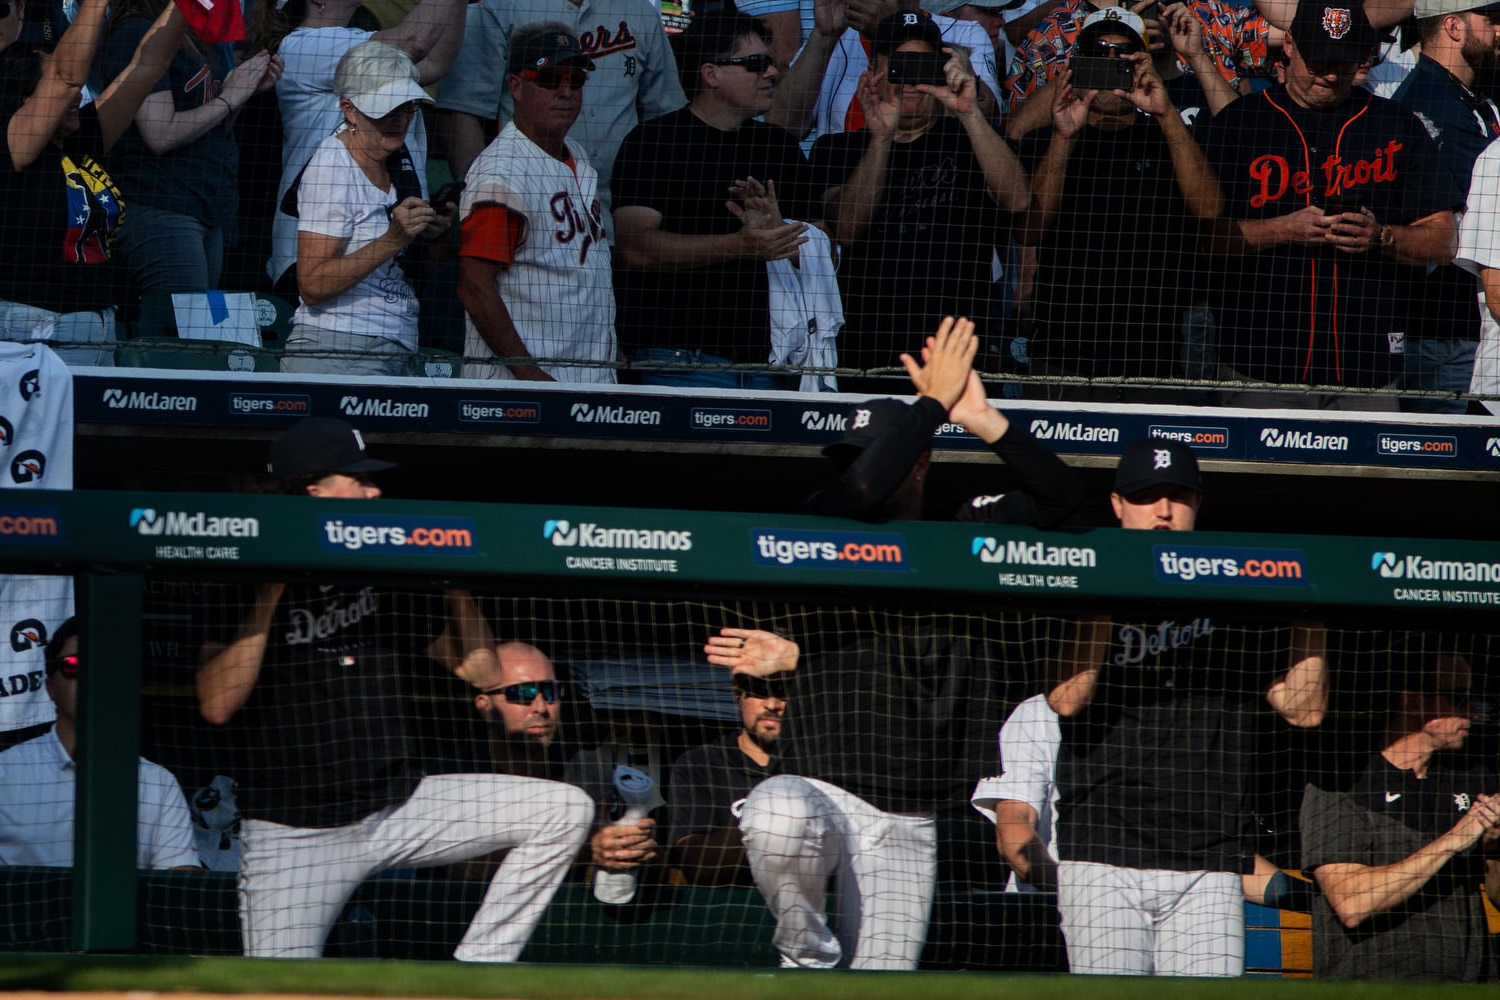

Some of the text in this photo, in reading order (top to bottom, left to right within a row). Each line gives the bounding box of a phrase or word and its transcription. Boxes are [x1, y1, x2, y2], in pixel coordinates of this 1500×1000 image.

[903, 13, 917, 26] D
[128, 391, 197, 412] McLaren
[232, 396, 308, 414] tigers.com
[363, 399, 429, 419] McLaren
[462, 403, 537, 421] tigers.com
[594, 405, 660, 426] McLaren
[694, 410, 768, 428] tigers.com
[853, 408, 871, 429] D
[1054, 421, 1119, 443] McLaren
[1283, 430, 1349, 452] McLaren
[1381, 436, 1454, 453] tigers.com
[1154, 449, 1171, 470] D
[164, 511, 258, 537] McLaren
[325, 519, 472, 548] tigers.com
[578, 524, 691, 551] Karmanos
[156, 545, 240, 559] HEALTH CARE
[758, 535, 902, 563] tigers.com
[1005, 540, 1095, 568] McLaren
[566, 557, 678, 572] CANCER INSTITUTE
[1160, 551, 1301, 580] tigers.com
[999, 573, 1079, 588] HEALTH CARE
[1394, 588, 1500, 603] CANCER INSTITUTE
